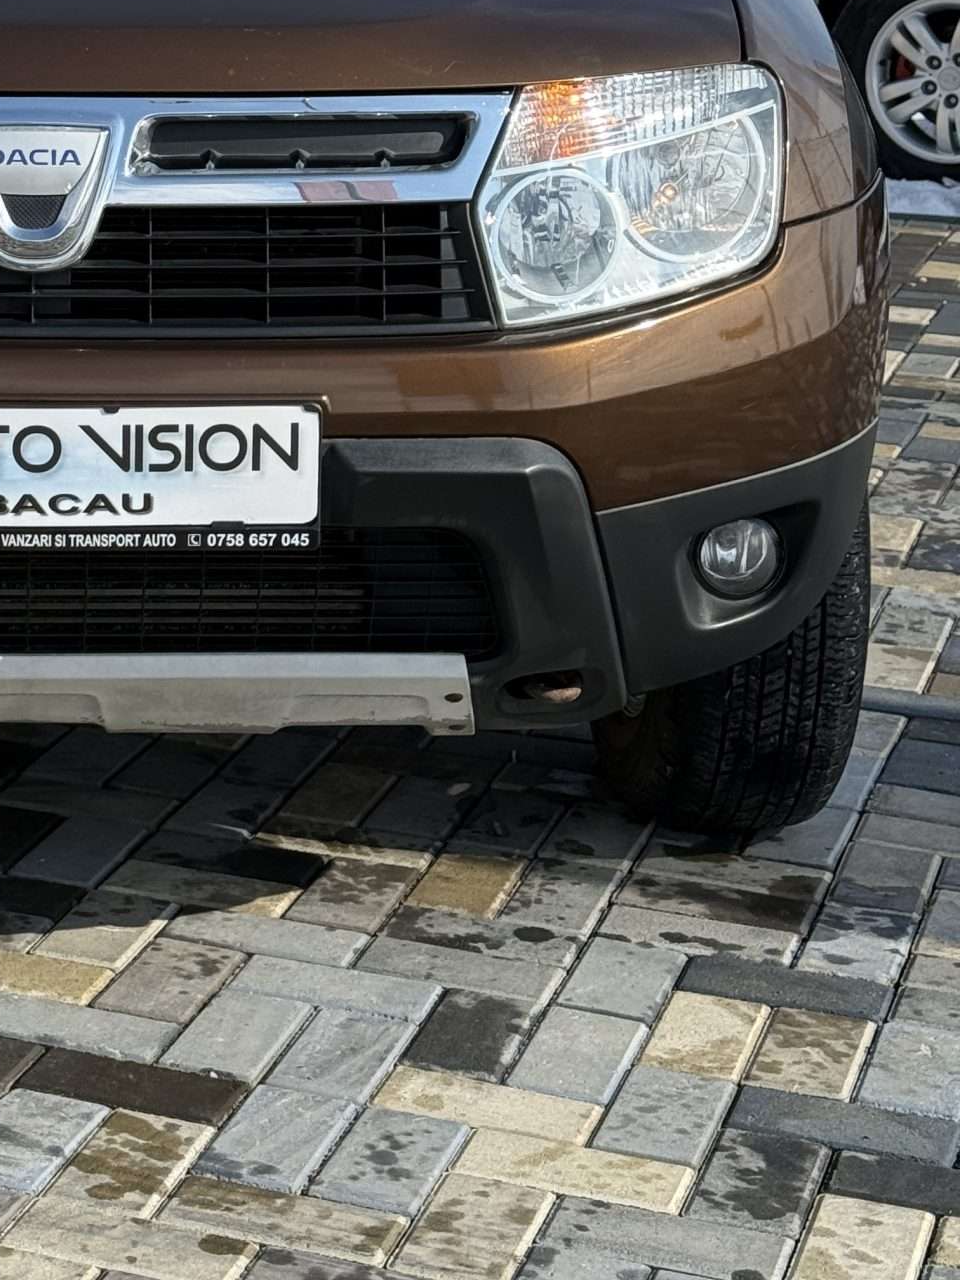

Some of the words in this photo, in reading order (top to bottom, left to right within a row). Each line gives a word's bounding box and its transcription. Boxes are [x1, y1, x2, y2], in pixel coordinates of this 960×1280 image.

[78, 422, 300, 473] VISION
[1, 533, 52, 547] VANZARI
[54, 534, 67, 547] SI
[68, 534, 141, 547] TRANSPORT
[143, 534, 176, 547] AUTO
[207, 534, 244, 546] 0758
[248, 534, 277, 546] 657
[281, 533, 310, 546] 045
